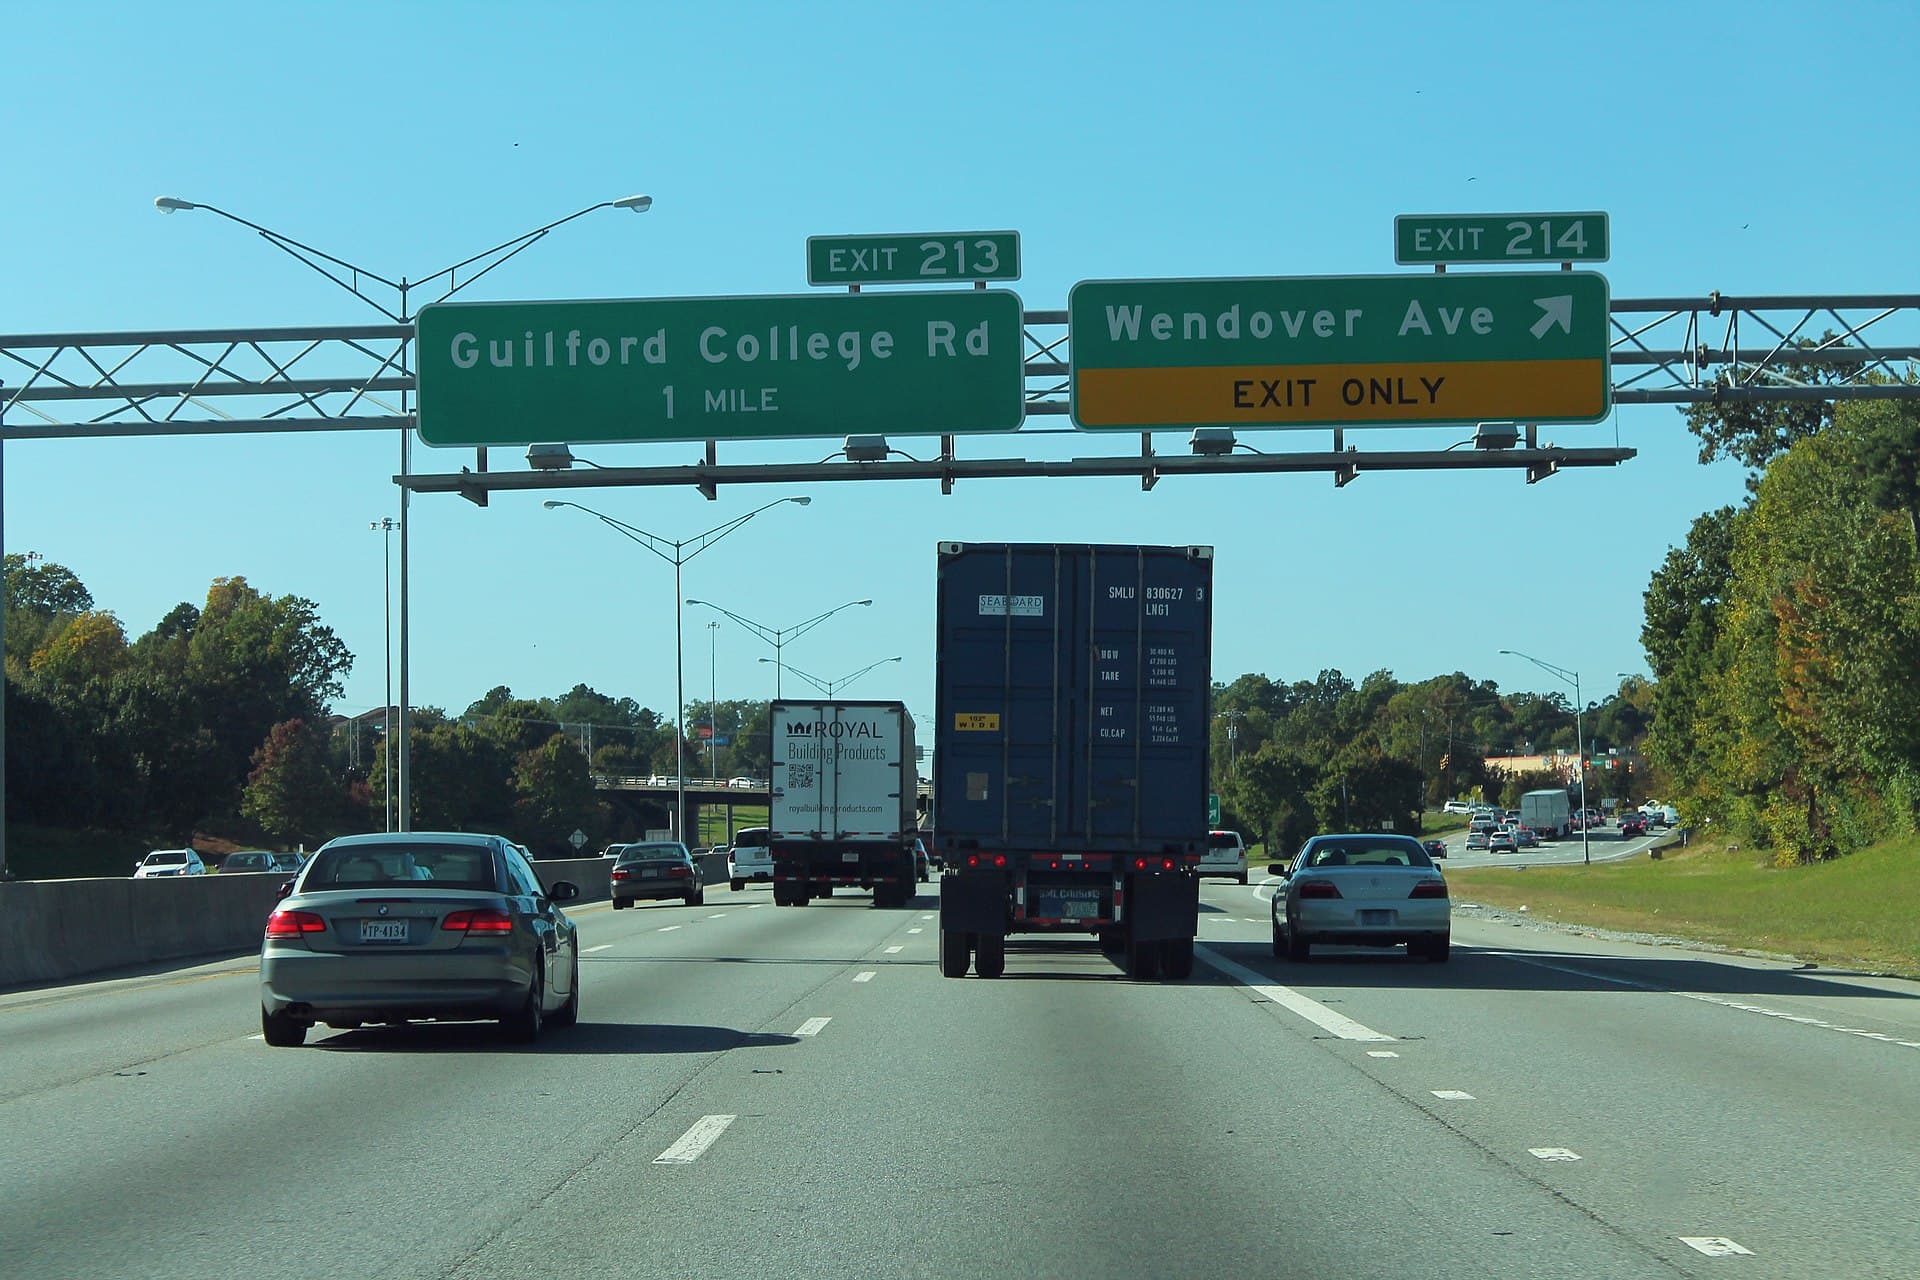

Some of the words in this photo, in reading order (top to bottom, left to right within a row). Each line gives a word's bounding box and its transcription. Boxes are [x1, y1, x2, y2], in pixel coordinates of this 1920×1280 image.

[1414, 227, 1485, 252] EXIT
[1505, 220, 1588, 255] 214
[829, 247, 898, 273] EXIT
[919, 239, 999, 275] 213
[1105, 303, 1363, 342] Wendover
[1397, 299, 1494, 336] Ave
[450, 327, 666, 369] Guilford
[699, 325, 894, 372] College
[927, 319, 989, 357] Rd
[1234, 379, 1317, 409] EXIT
[1342, 376, 1445, 406] ONLY
[662, 385, 674, 419] 1
[704, 387, 779, 413] MILE
[1109, 586, 1135, 599] SMLU
[1146, 587, 1183, 600] 830627
[1146, 603, 1170, 616] LNG1
[1101, 671, 1120, 681] TARE
[1100, 706, 1113, 717] NET
[814, 721, 884, 739] ROYAL
[836, 743, 886, 761] Products
[788, 804, 883, 815] royalbuilingroducts.com
